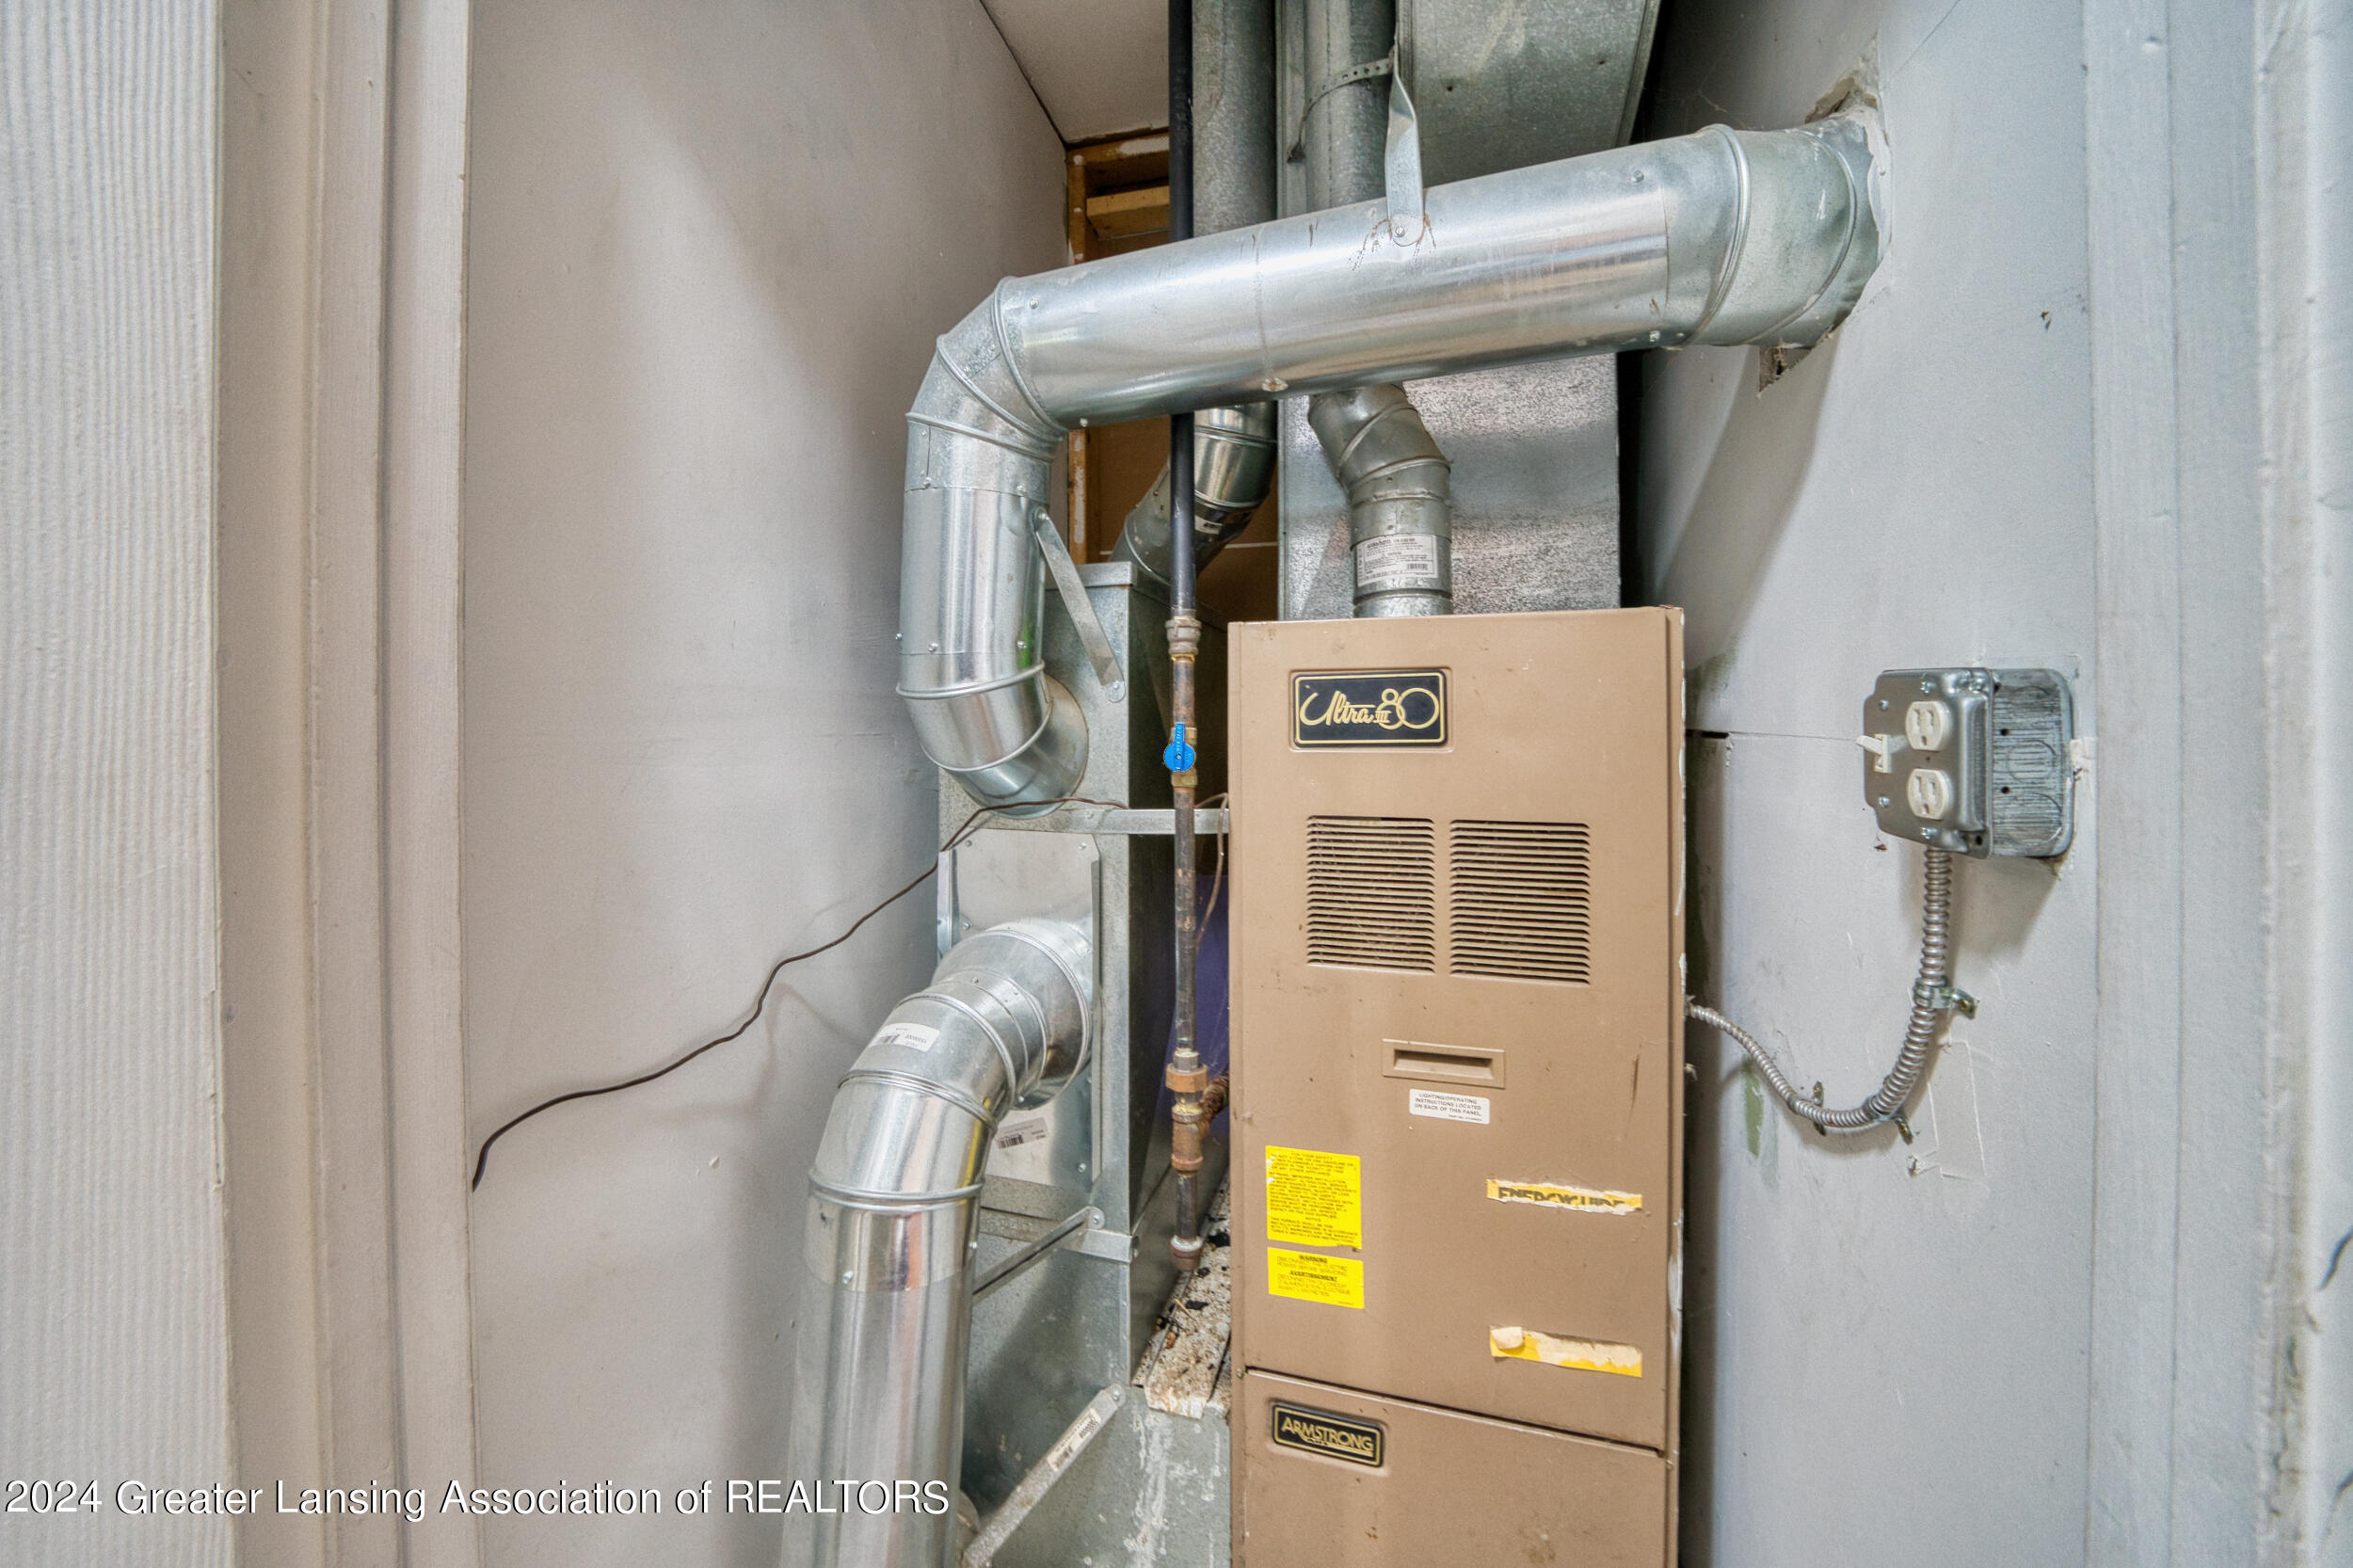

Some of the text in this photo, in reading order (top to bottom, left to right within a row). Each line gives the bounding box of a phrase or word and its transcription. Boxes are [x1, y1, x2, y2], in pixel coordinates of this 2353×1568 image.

[1299, 691, 1374, 726] Ultra
[1376, 687, 1440, 730] 80
[1455, 1102, 1481, 1111] LOCATED
[1281, 1416, 1375, 1454] ARMSTRONG
